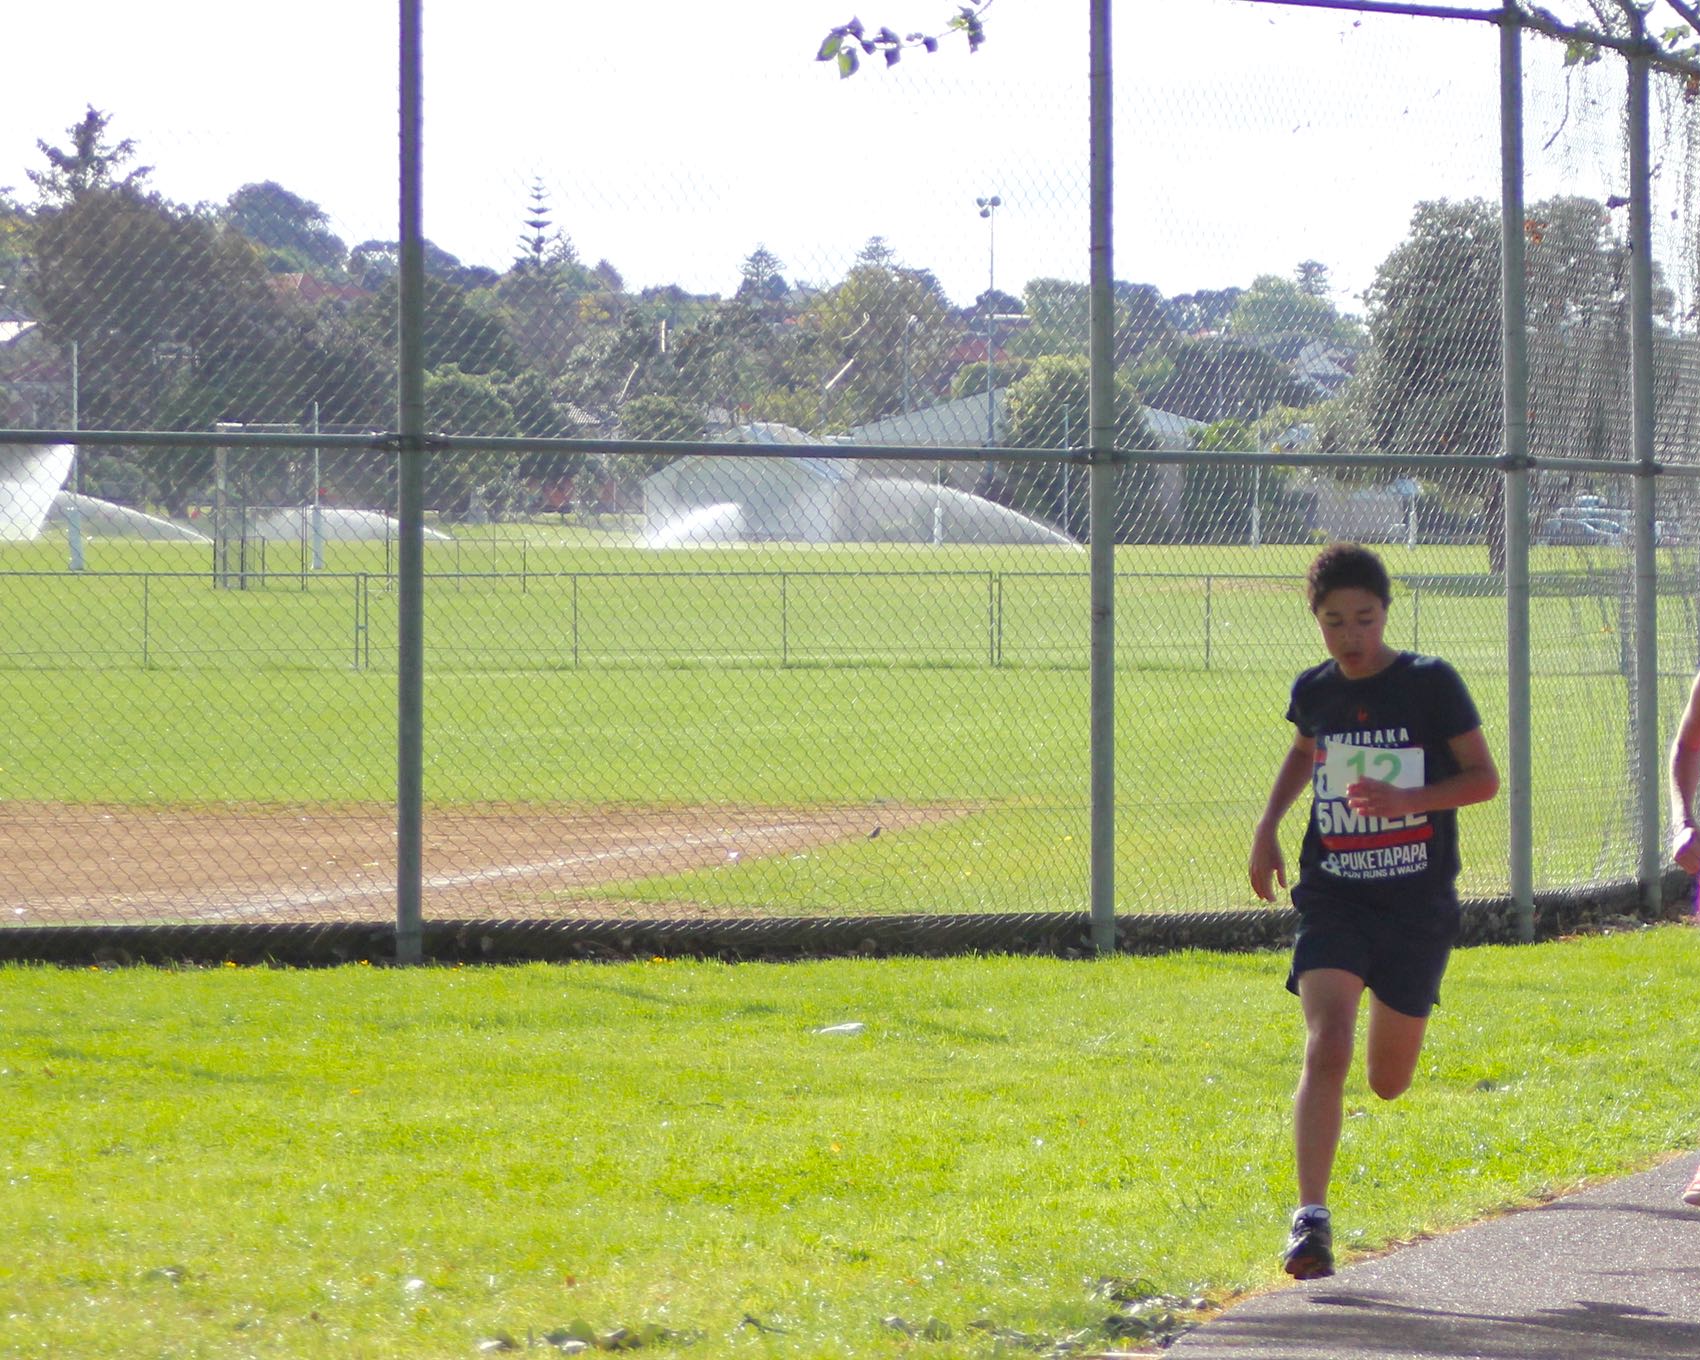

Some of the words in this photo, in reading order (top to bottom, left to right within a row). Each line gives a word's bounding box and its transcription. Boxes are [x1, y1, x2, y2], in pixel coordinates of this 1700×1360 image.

[1346, 750, 1402, 784] 12
[1341, 842, 1428, 870] PUKETAPAPA
[1363, 868, 1388, 879] RUNS
